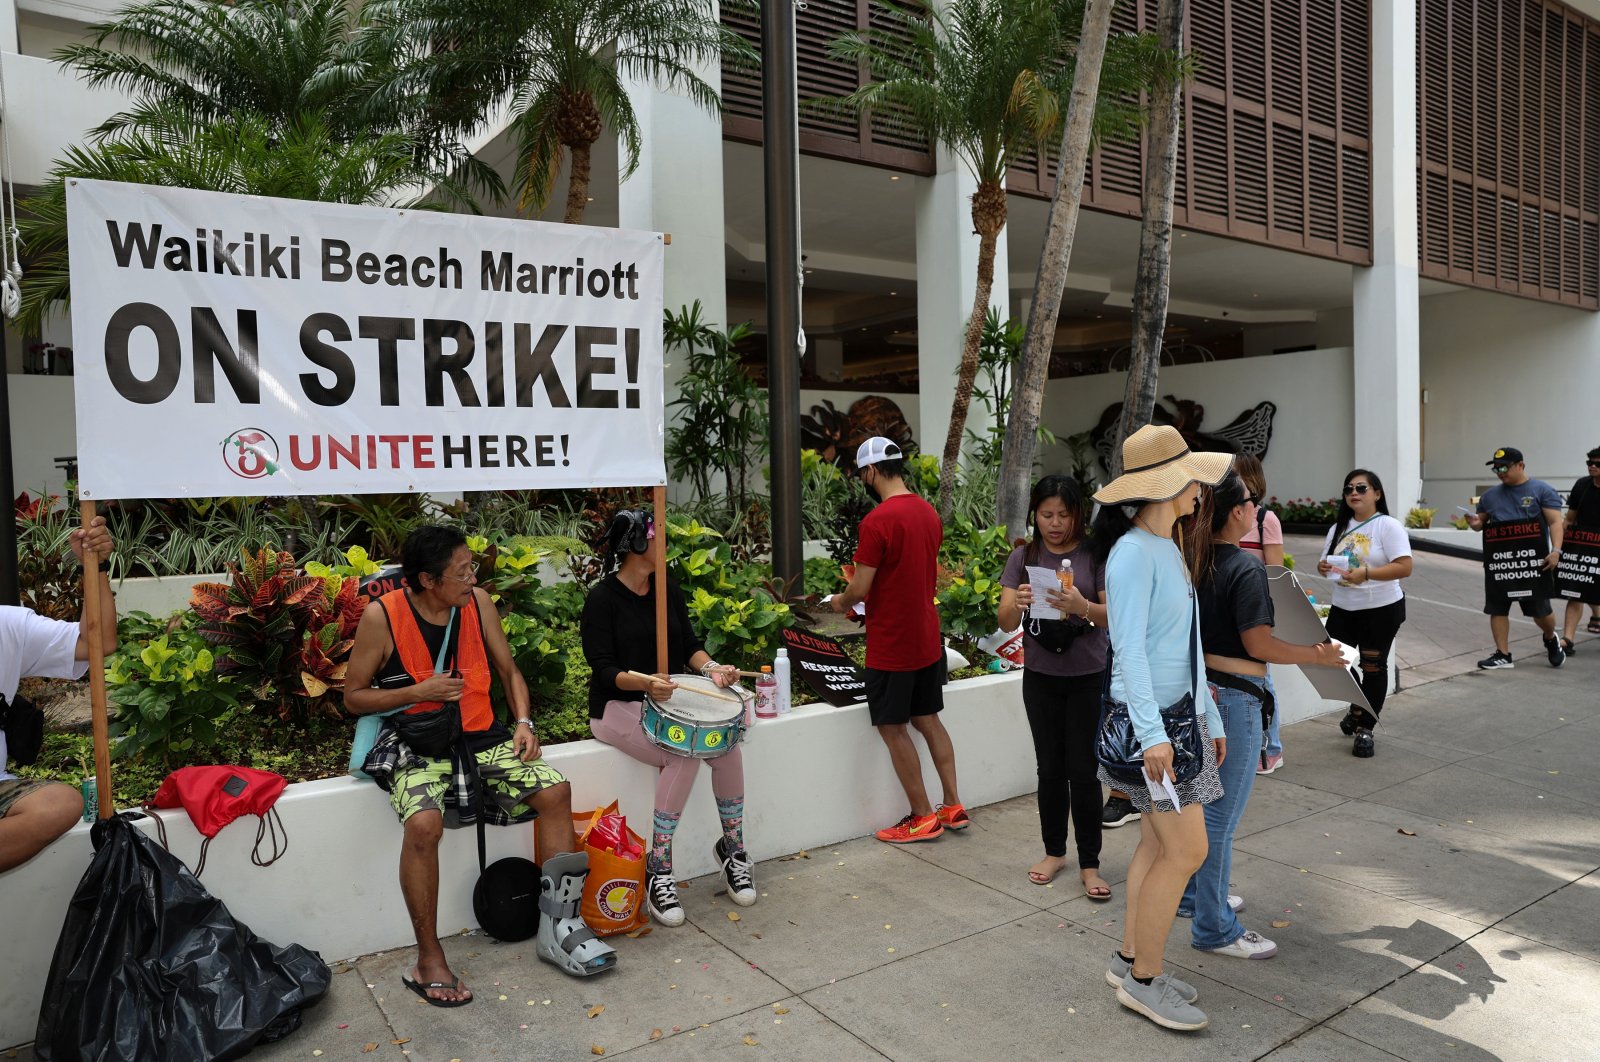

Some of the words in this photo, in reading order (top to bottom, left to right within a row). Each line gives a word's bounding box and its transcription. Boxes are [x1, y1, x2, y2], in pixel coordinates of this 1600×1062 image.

[106, 220, 300, 279] Waikiki
[321, 238, 463, 289] Beach
[481, 250, 639, 300] Marriott
[104, 302, 260, 404] ON
[299, 312, 641, 408] STRIKE!
[1486, 528, 1497, 537] ON
[1500, 523, 1540, 536] STRIKE
[1493, 551, 1513, 560] ONE
[1516, 549, 1536, 558] JOB
[1563, 553, 1578, 561] ONE
[1580, 555, 1598, 564] JOB
[1489, 561, 1527, 571] SHOULD
[1530, 559, 1544, 567] BE
[1495, 570, 1541, 581] ENOUGH.
[1558, 571, 1594, 583] ENOUGH.
[368, 579, 394, 596] ON
[783, 628, 800, 643] ON
[800, 634, 841, 653] STRIKE
[800, 660, 857, 674] RESPECT
[824, 674, 856, 682] OUR
